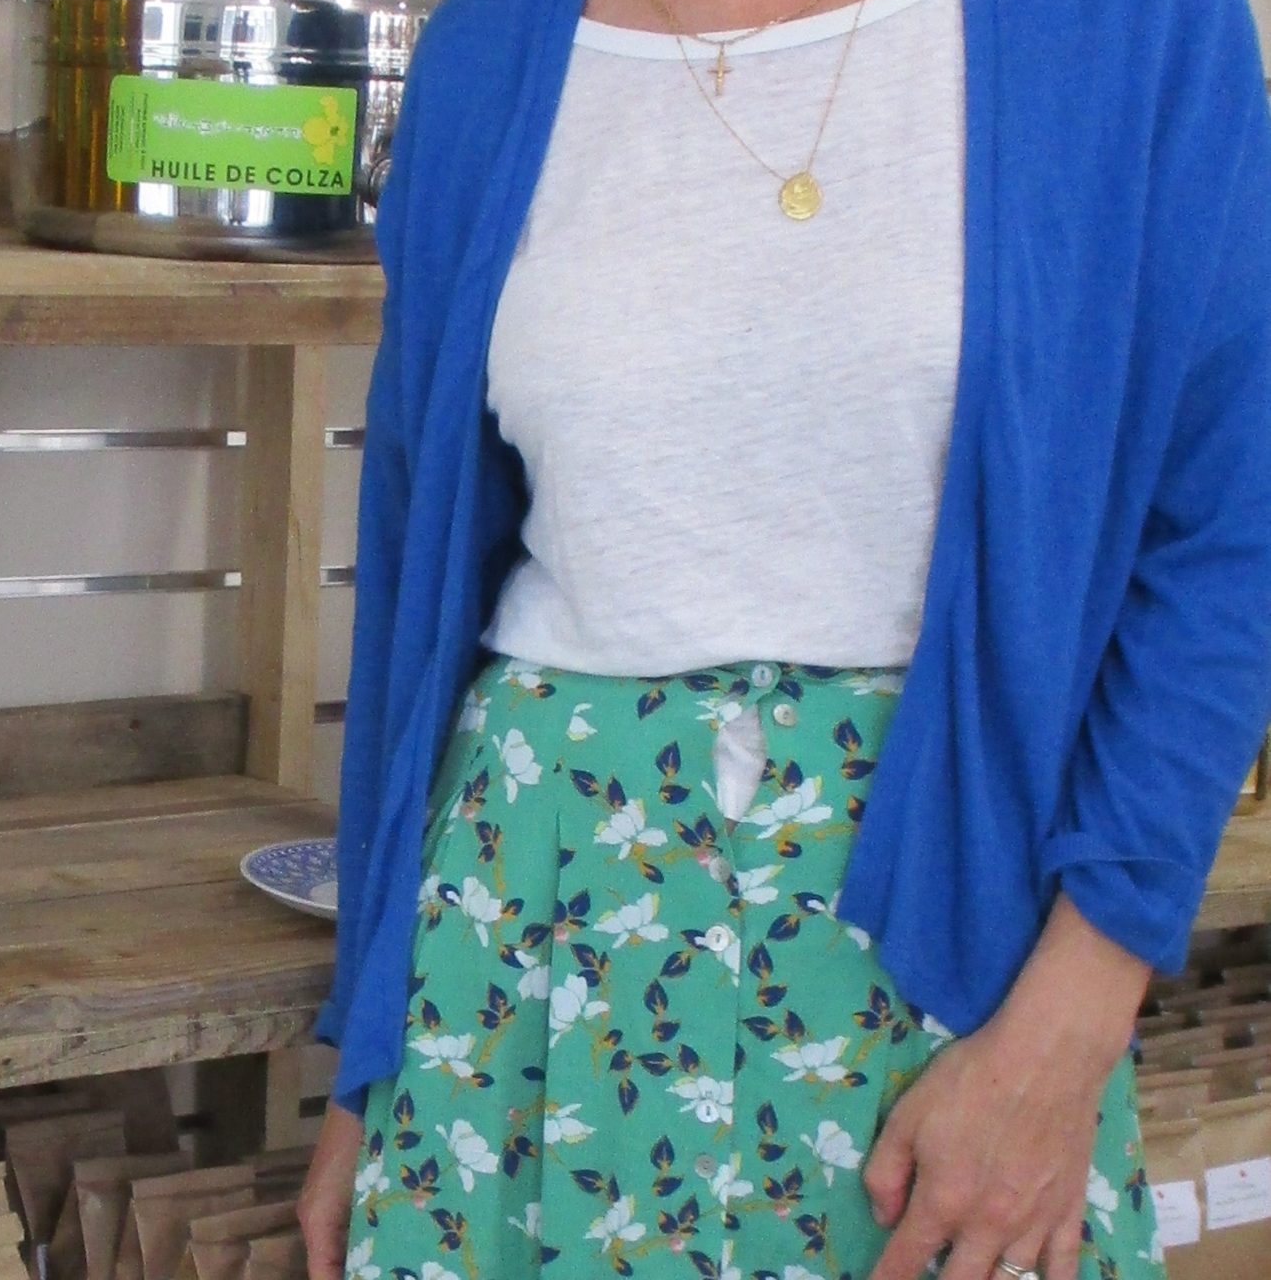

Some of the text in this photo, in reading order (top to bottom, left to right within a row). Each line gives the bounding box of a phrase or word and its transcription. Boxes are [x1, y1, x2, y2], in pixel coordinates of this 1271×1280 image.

[152, 160, 345, 188] HUILE DE COLZA
